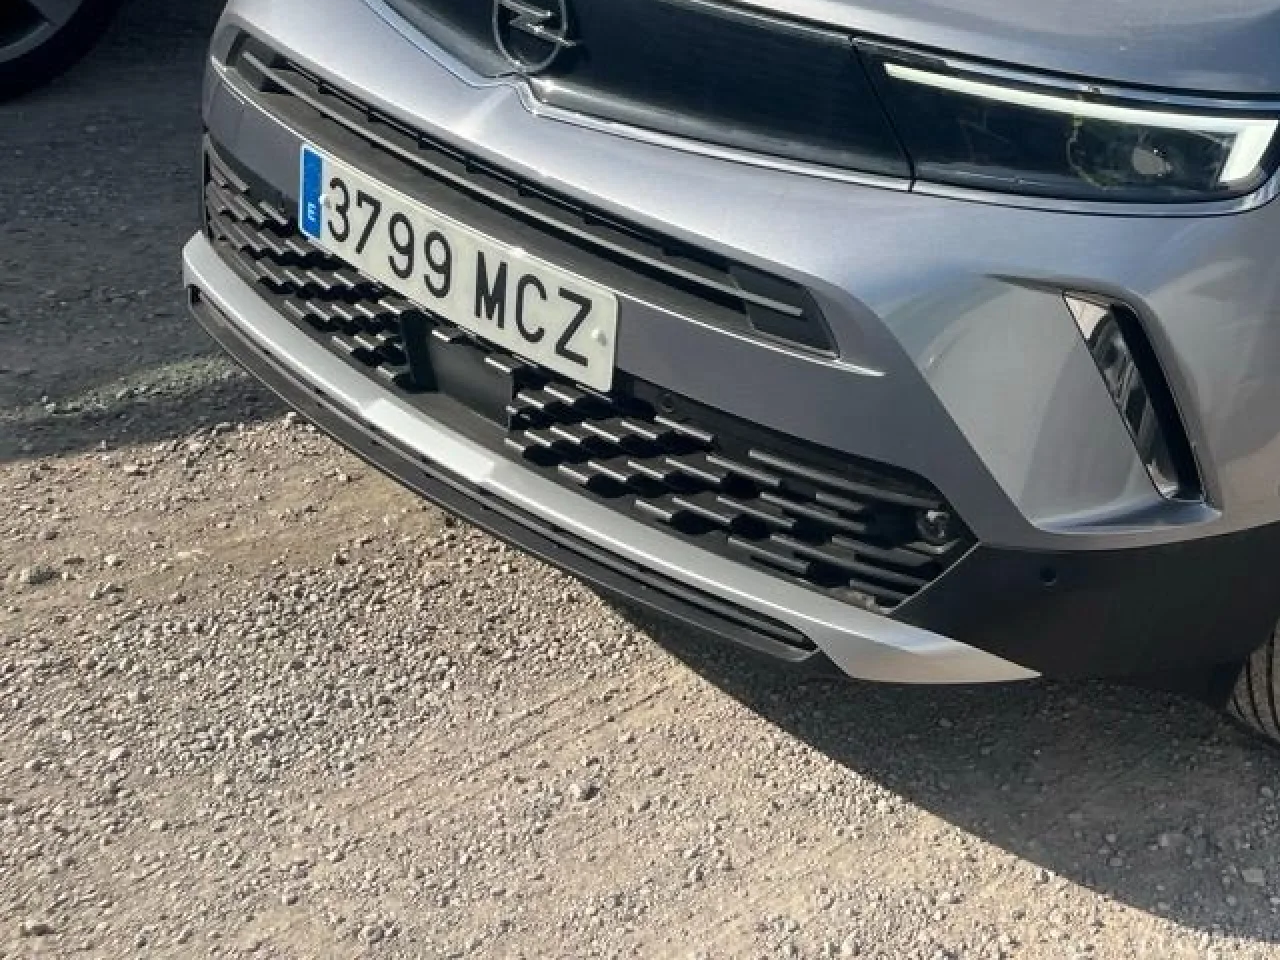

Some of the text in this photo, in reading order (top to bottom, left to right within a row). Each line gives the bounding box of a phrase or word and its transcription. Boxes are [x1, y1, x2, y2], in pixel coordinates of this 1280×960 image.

[307, 202, 316, 222] E
[328, 178, 593, 366] 3799 MCZ
